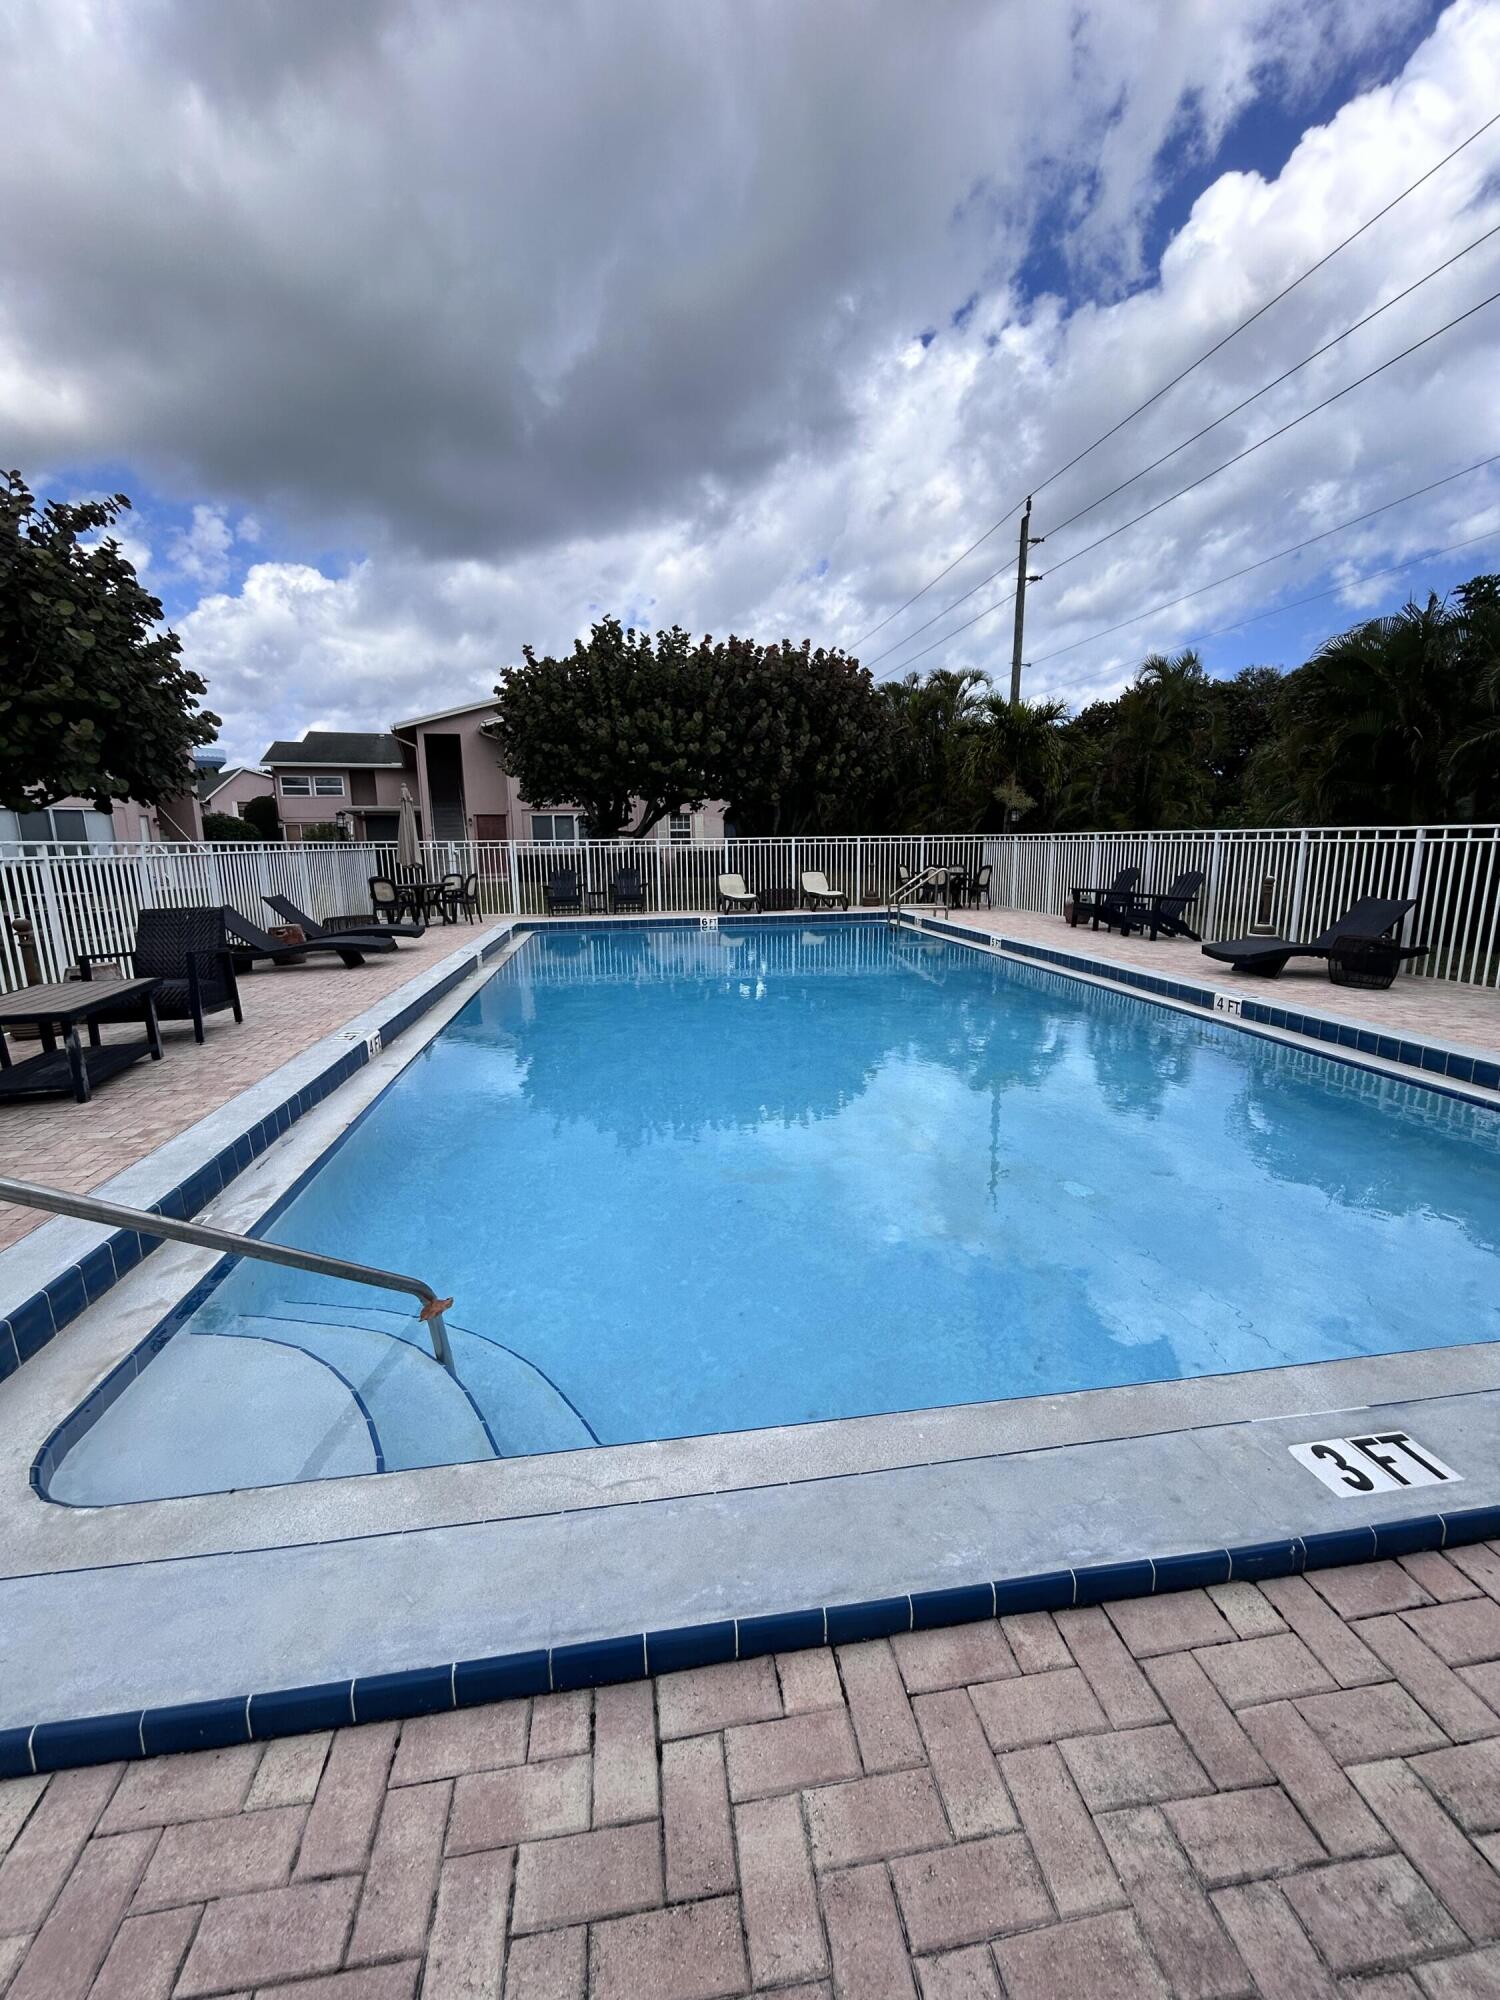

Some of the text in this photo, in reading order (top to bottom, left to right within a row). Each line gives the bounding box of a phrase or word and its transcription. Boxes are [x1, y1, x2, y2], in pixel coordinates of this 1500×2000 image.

[702, 918, 708, 926] 6
[1217, 997, 1224, 1010] 4
[1311, 1433, 1449, 1492] 3 FT
